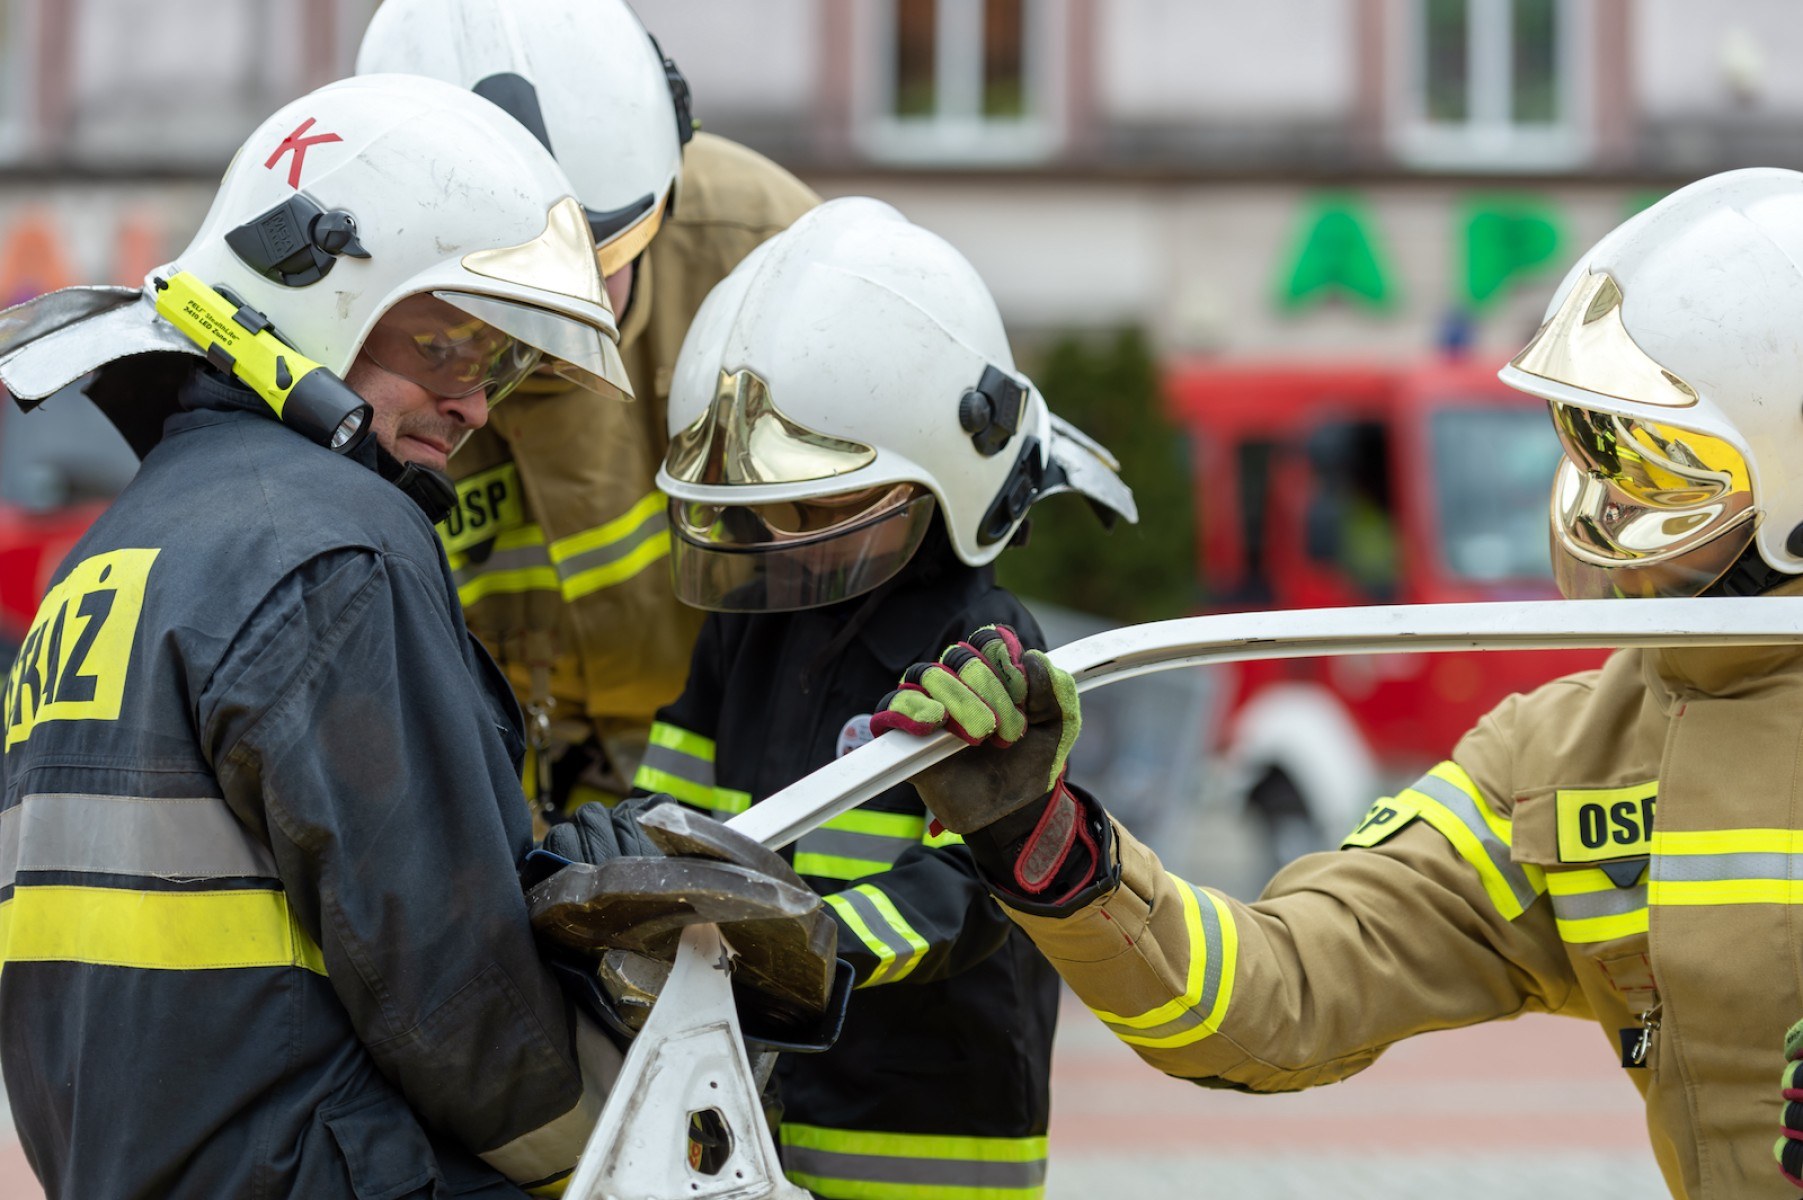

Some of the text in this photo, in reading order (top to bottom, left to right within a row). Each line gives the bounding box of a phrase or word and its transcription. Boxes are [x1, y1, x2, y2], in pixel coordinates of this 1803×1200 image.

[264, 117, 343, 190] K
[199, 318, 212, 330] LED
[212, 328, 227, 342] Zone
